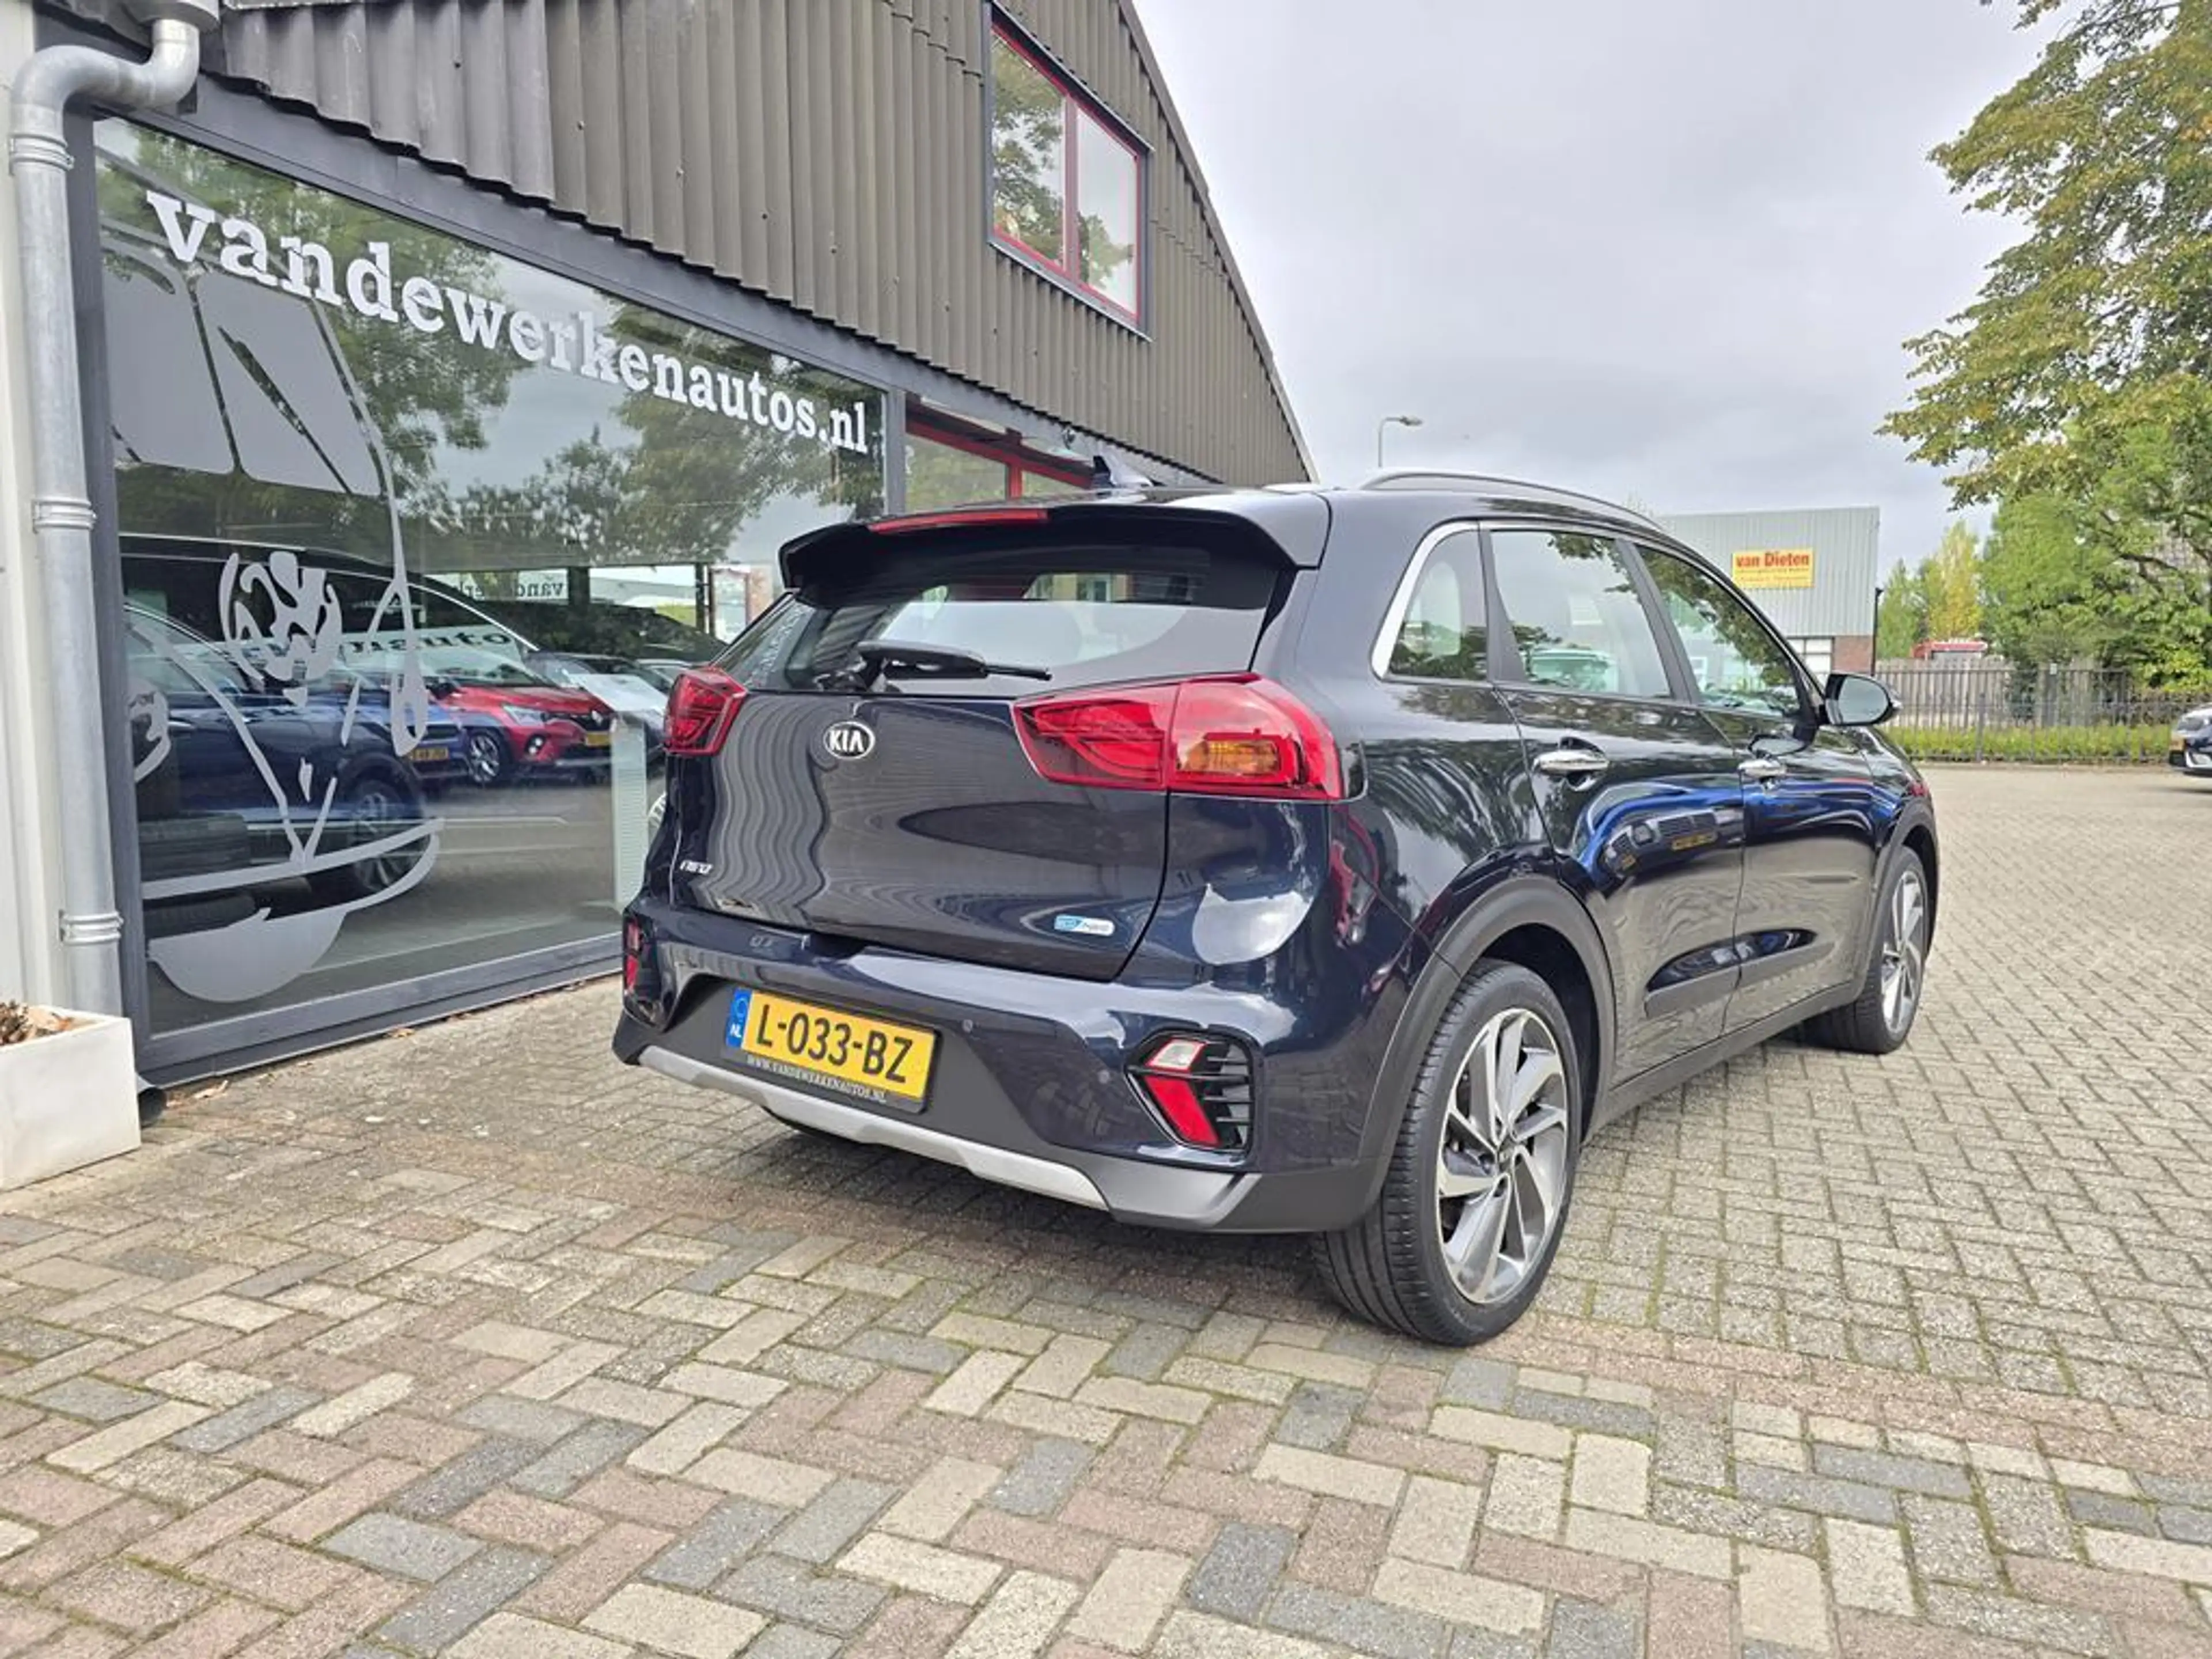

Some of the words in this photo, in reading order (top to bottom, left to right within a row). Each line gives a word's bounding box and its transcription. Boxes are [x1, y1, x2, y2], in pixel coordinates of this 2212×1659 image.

[146, 190, 867, 454] vandewerkenautos.nl
[1736, 555, 1760, 568] van
[1764, 551, 1809, 567] Dieten
[829, 730, 864, 752] KIA
[729, 1024, 742, 1038] NL
[756, 1003, 913, 1084] L-033-BZ
